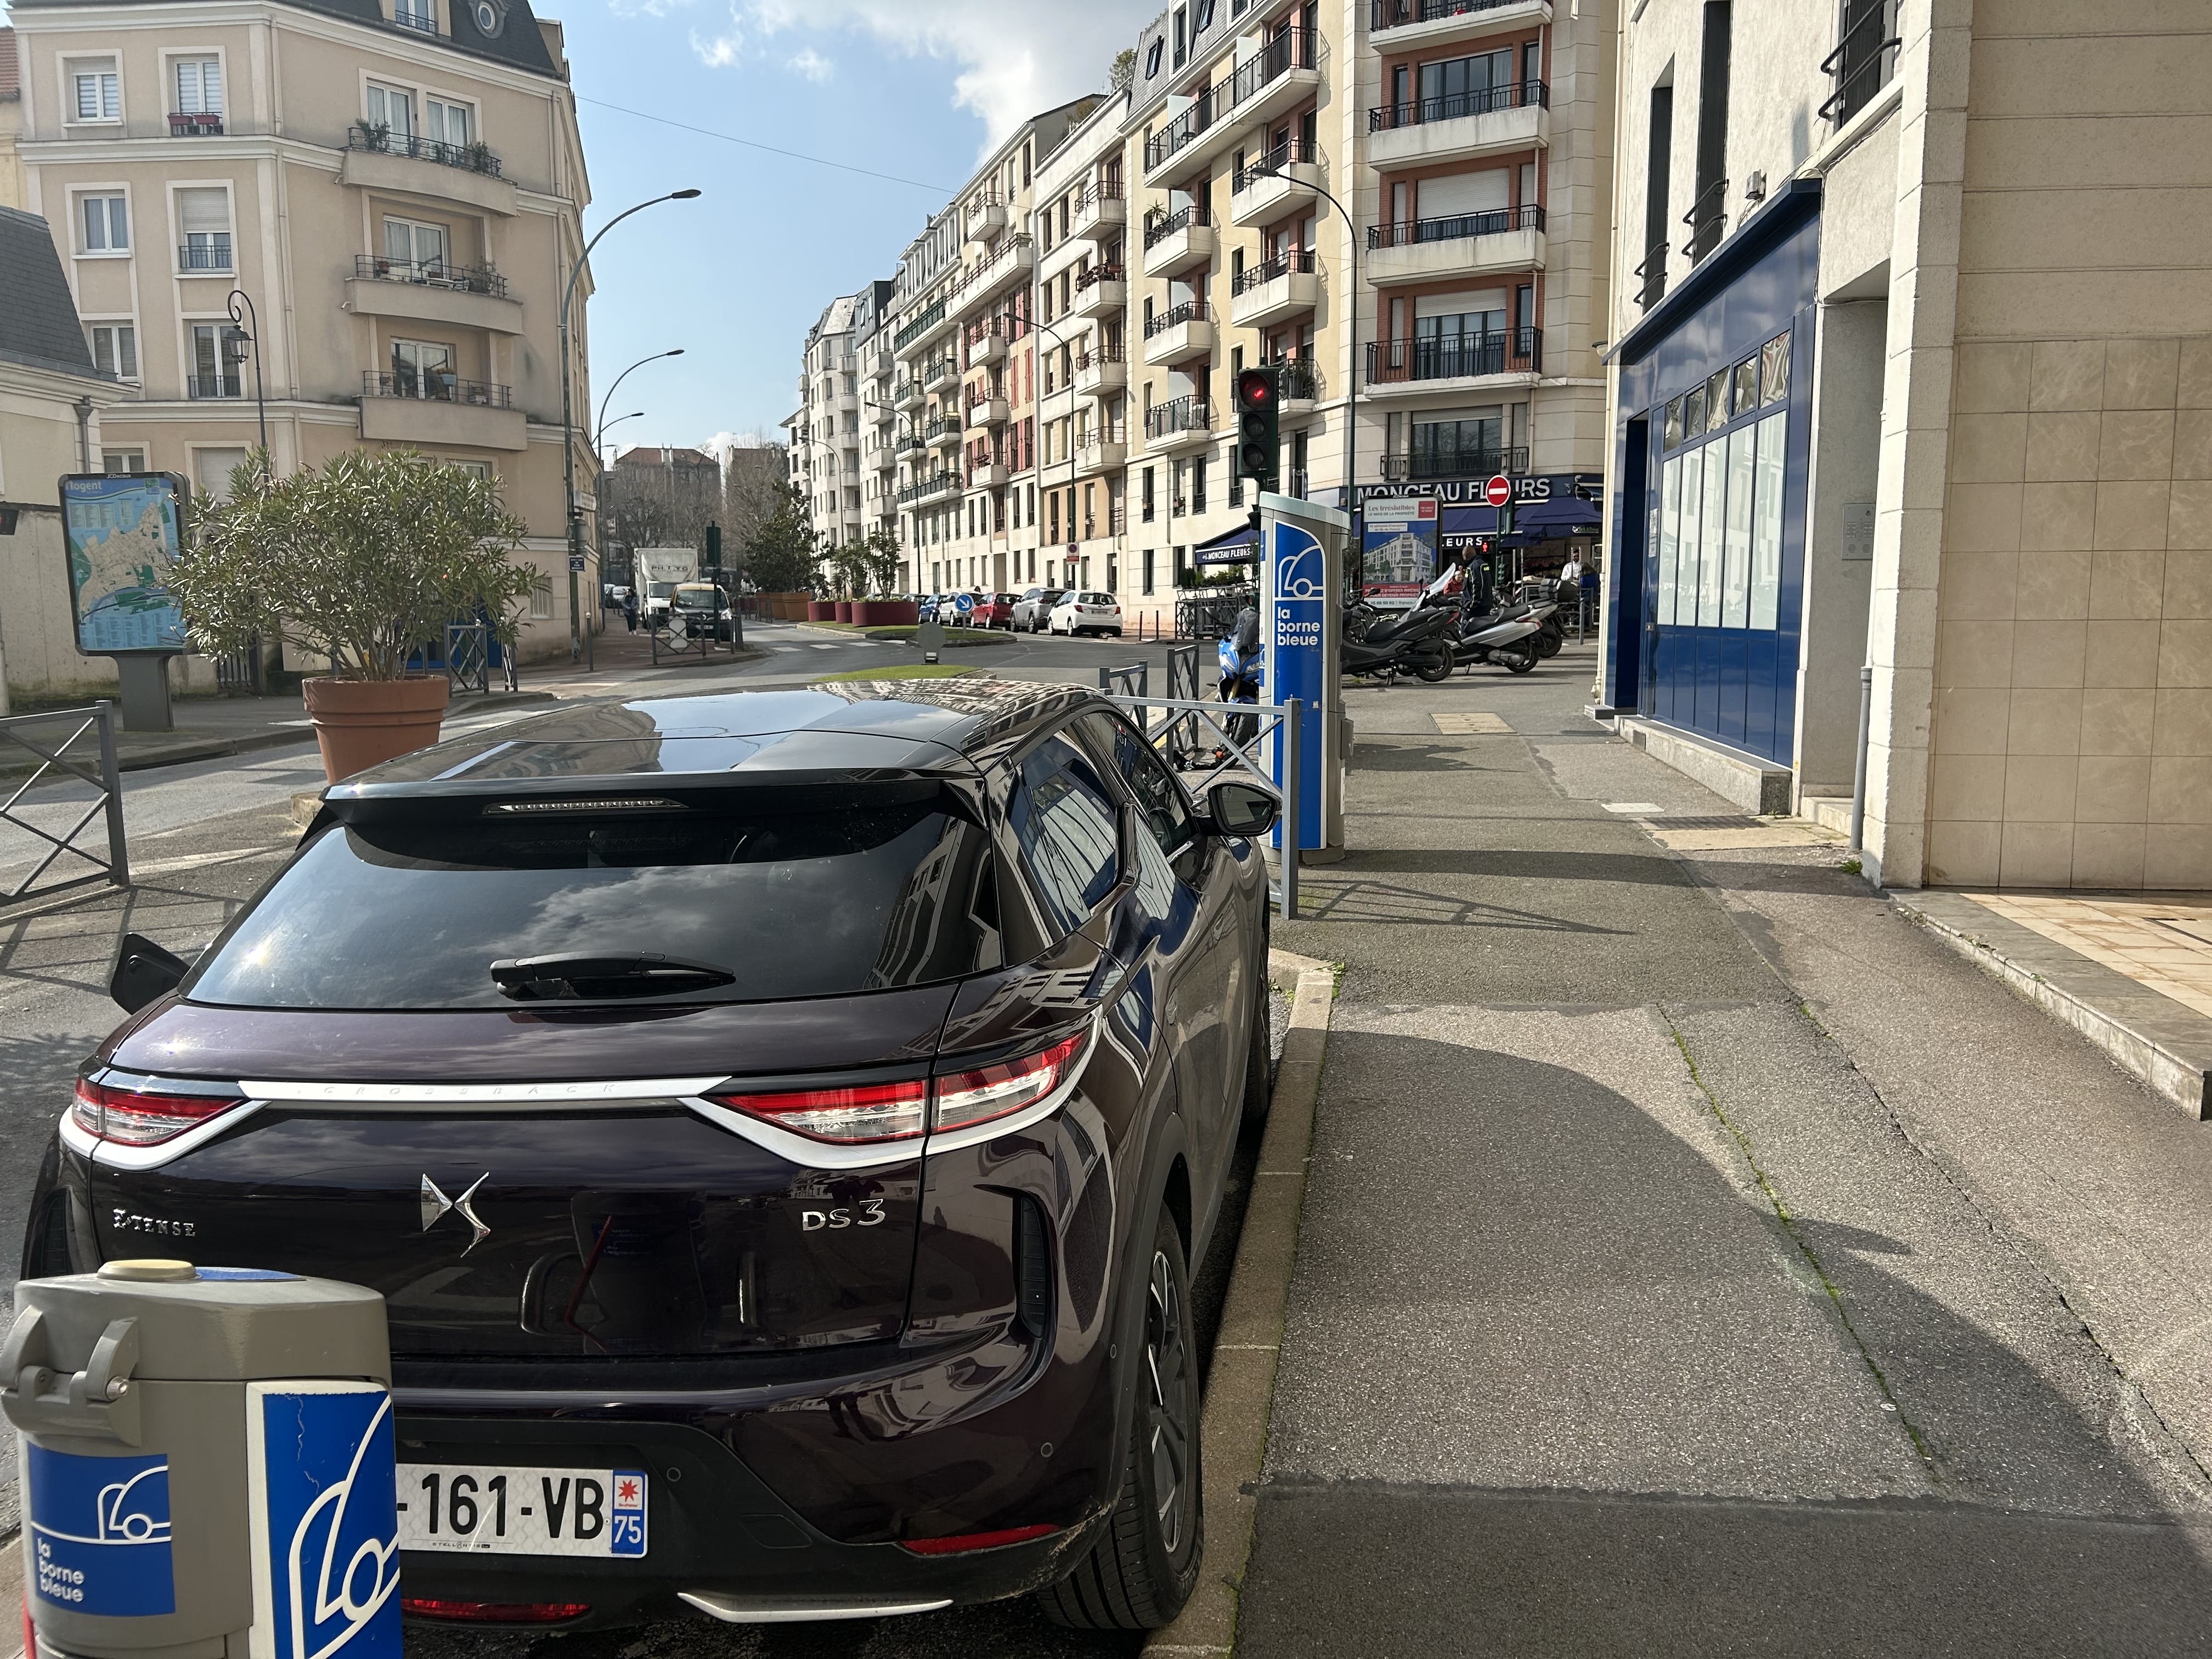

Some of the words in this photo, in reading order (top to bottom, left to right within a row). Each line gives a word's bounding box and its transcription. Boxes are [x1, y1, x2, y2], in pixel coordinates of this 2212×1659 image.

[1468, 478, 1550, 500] FLRS
[1442, 537, 1483, 547] EURS
[1208, 550, 1229, 560] MONCEAU
[1277, 606, 1290, 619] la
[1277, 620, 1321, 633] borne
[1277, 633, 1318, 646] bleue
[802, 1208, 851, 1231] DS
[857, 1198, 886, 1226] 3
[614, 1515, 642, 1544] 75
[37, 1537, 52, 1559] la
[38, 1555, 85, 1585] borne
[40, 1572, 84, 1602] bleue
